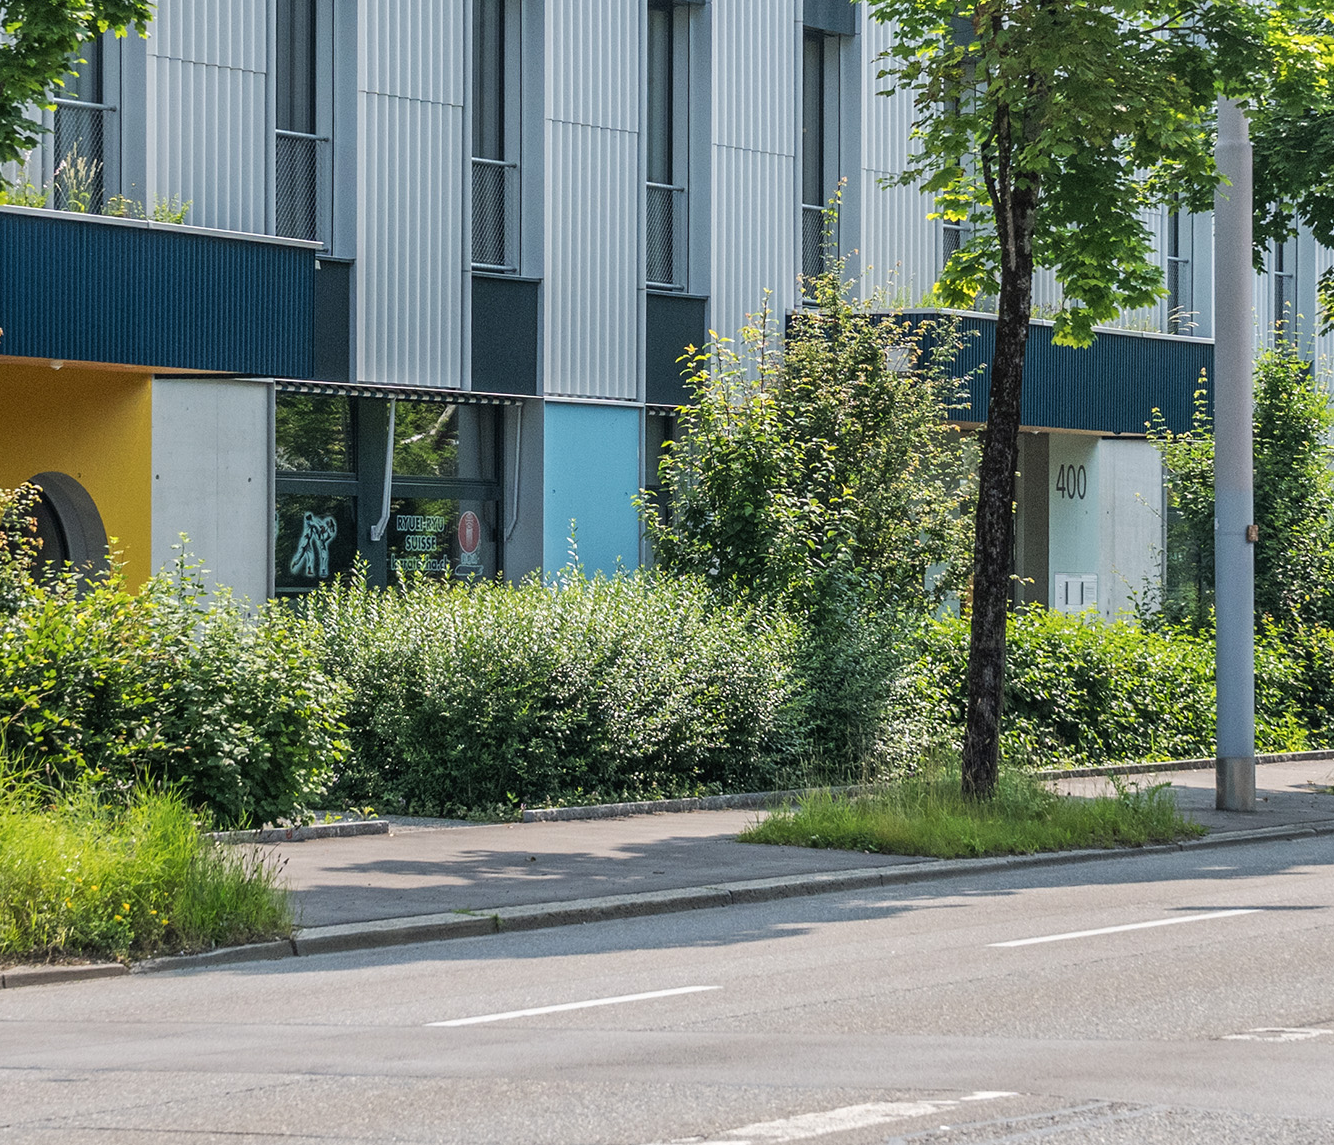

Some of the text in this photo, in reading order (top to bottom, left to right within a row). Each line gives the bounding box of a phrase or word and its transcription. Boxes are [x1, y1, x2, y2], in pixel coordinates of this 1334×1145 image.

[1056, 464, 1087, 500] 400
[397, 515, 444, 532] RYUEI-RYU
[406, 535, 437, 551] SUISSE
